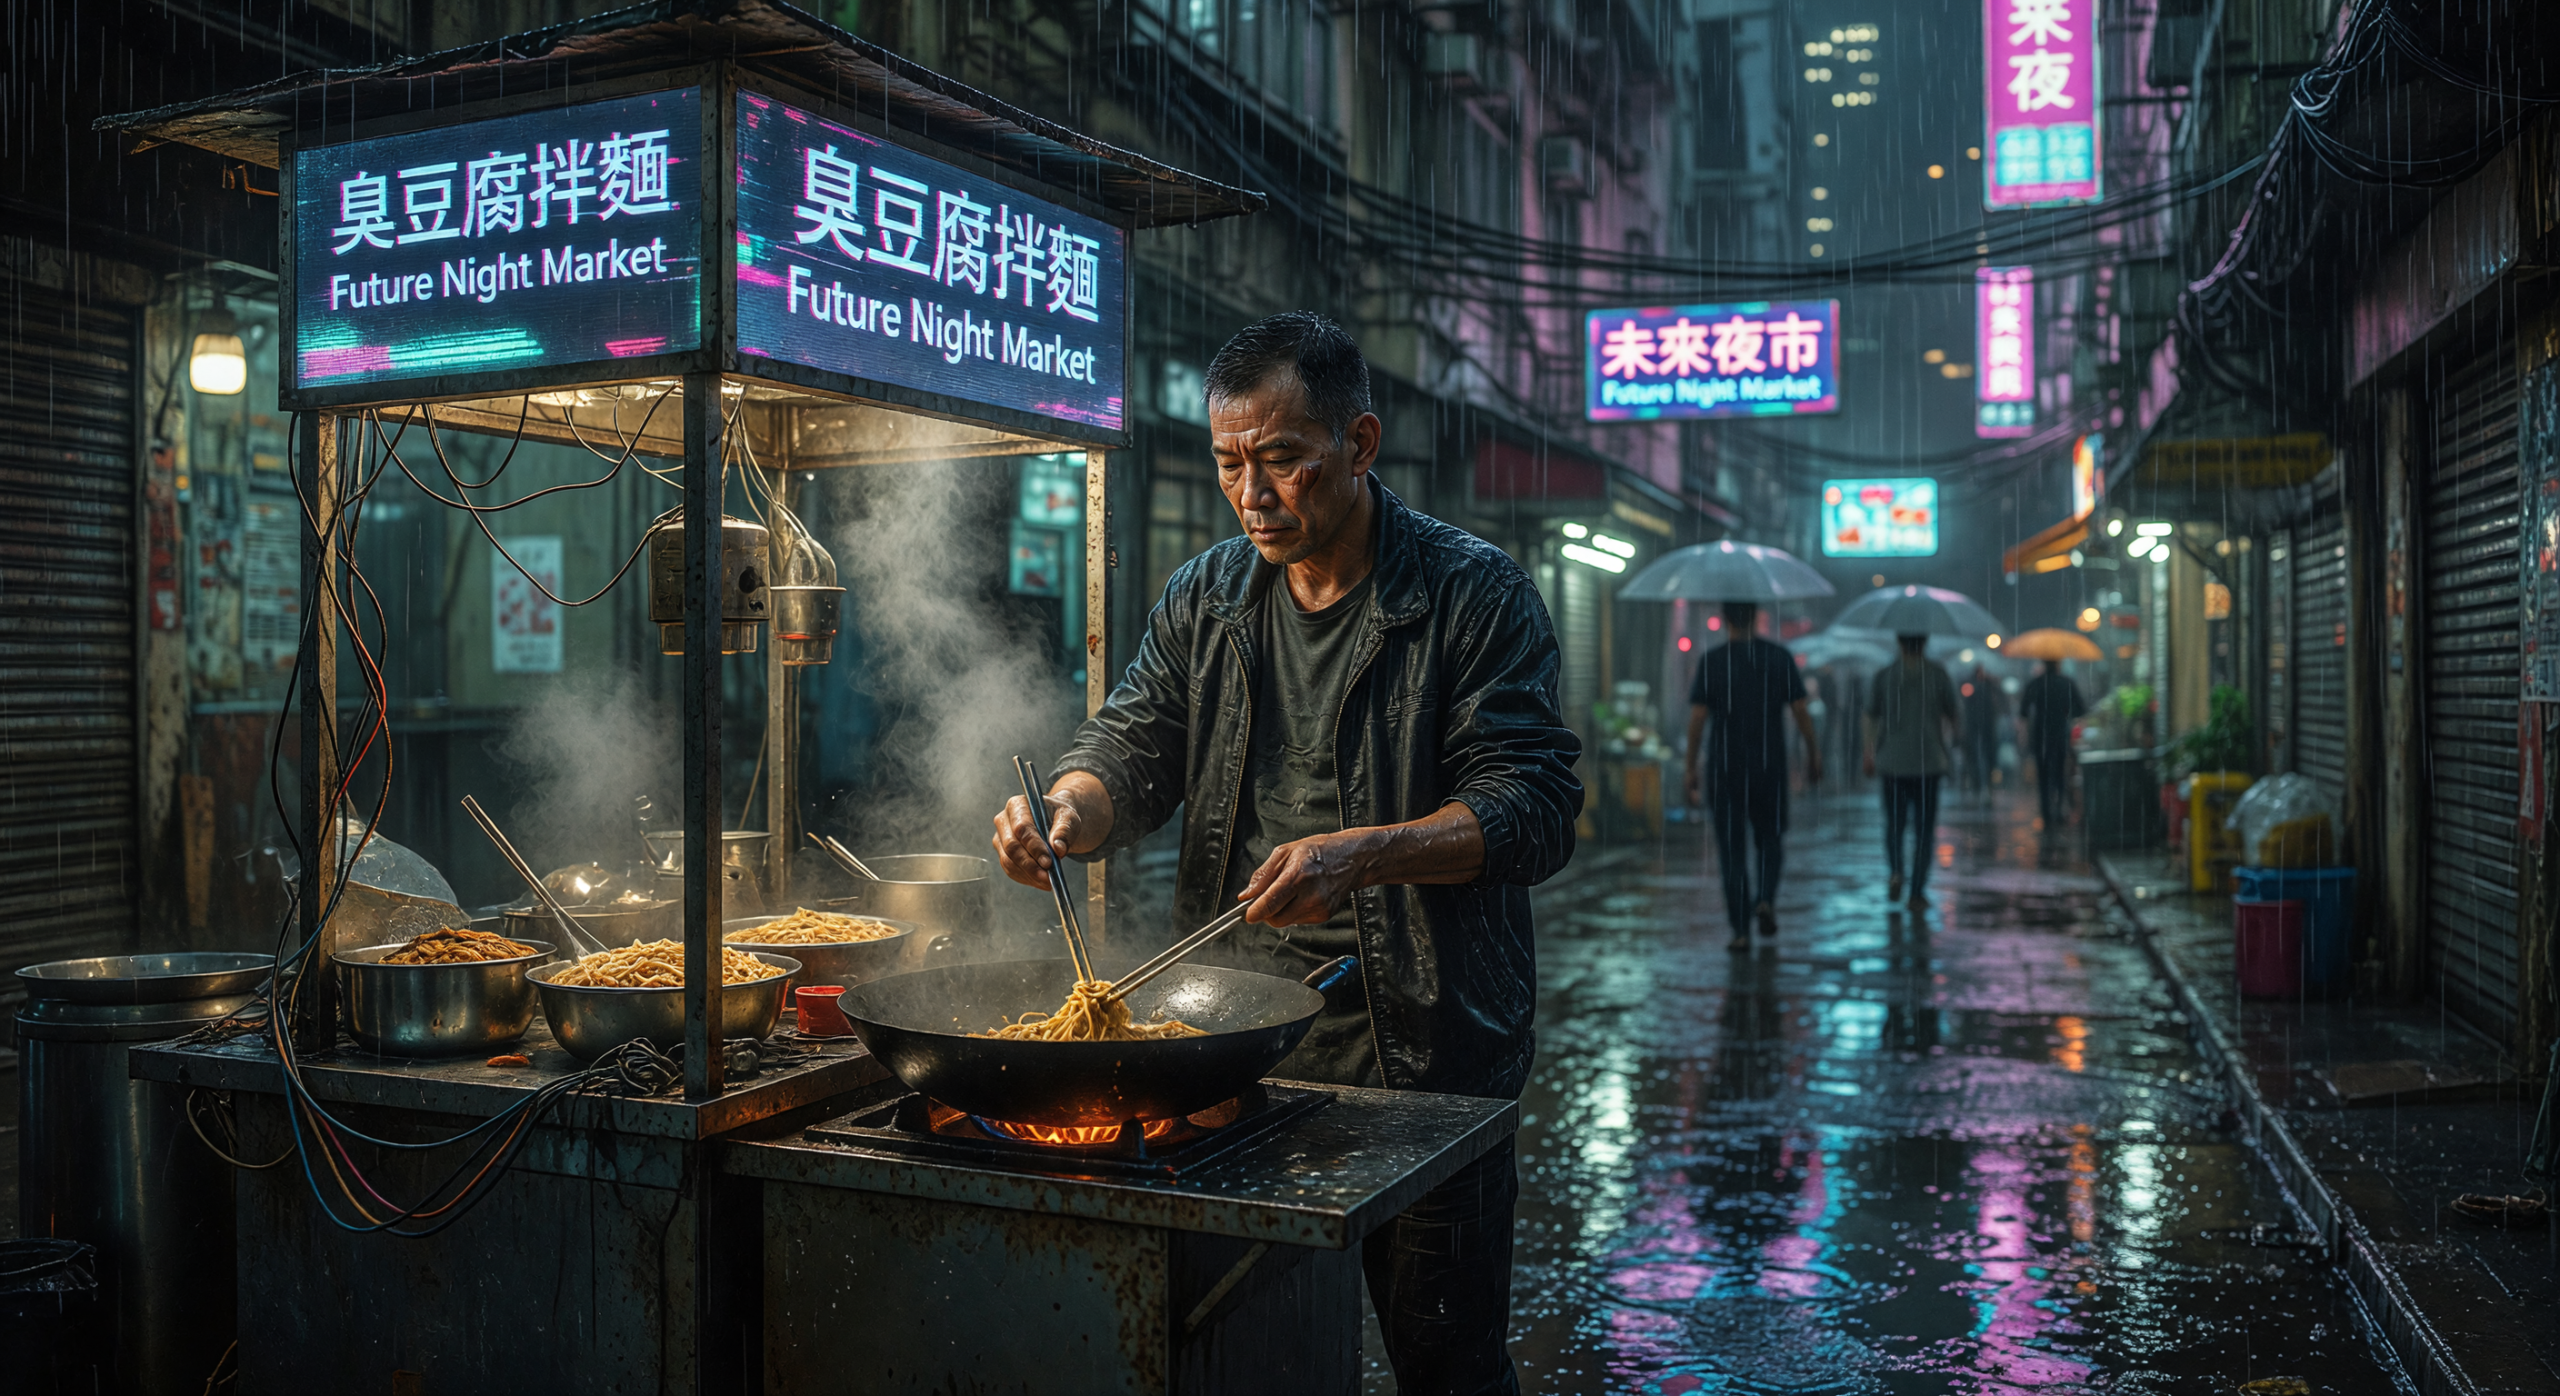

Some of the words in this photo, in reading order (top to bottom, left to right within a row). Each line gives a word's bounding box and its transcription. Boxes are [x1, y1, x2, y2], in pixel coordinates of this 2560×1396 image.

[331, 129, 671, 256] 臭豆腐拌麵
[793, 143, 1100, 323] 臭豆腐拌麵
[330, 271, 433, 310] Future
[442, 252, 534, 303] Night
[541, 237, 668, 286] Market
[787, 264, 901, 338] Future
[911, 296, 994, 364] Night
[1001, 321, 1097, 385] Market
[1675, 377, 1738, 408] Night
